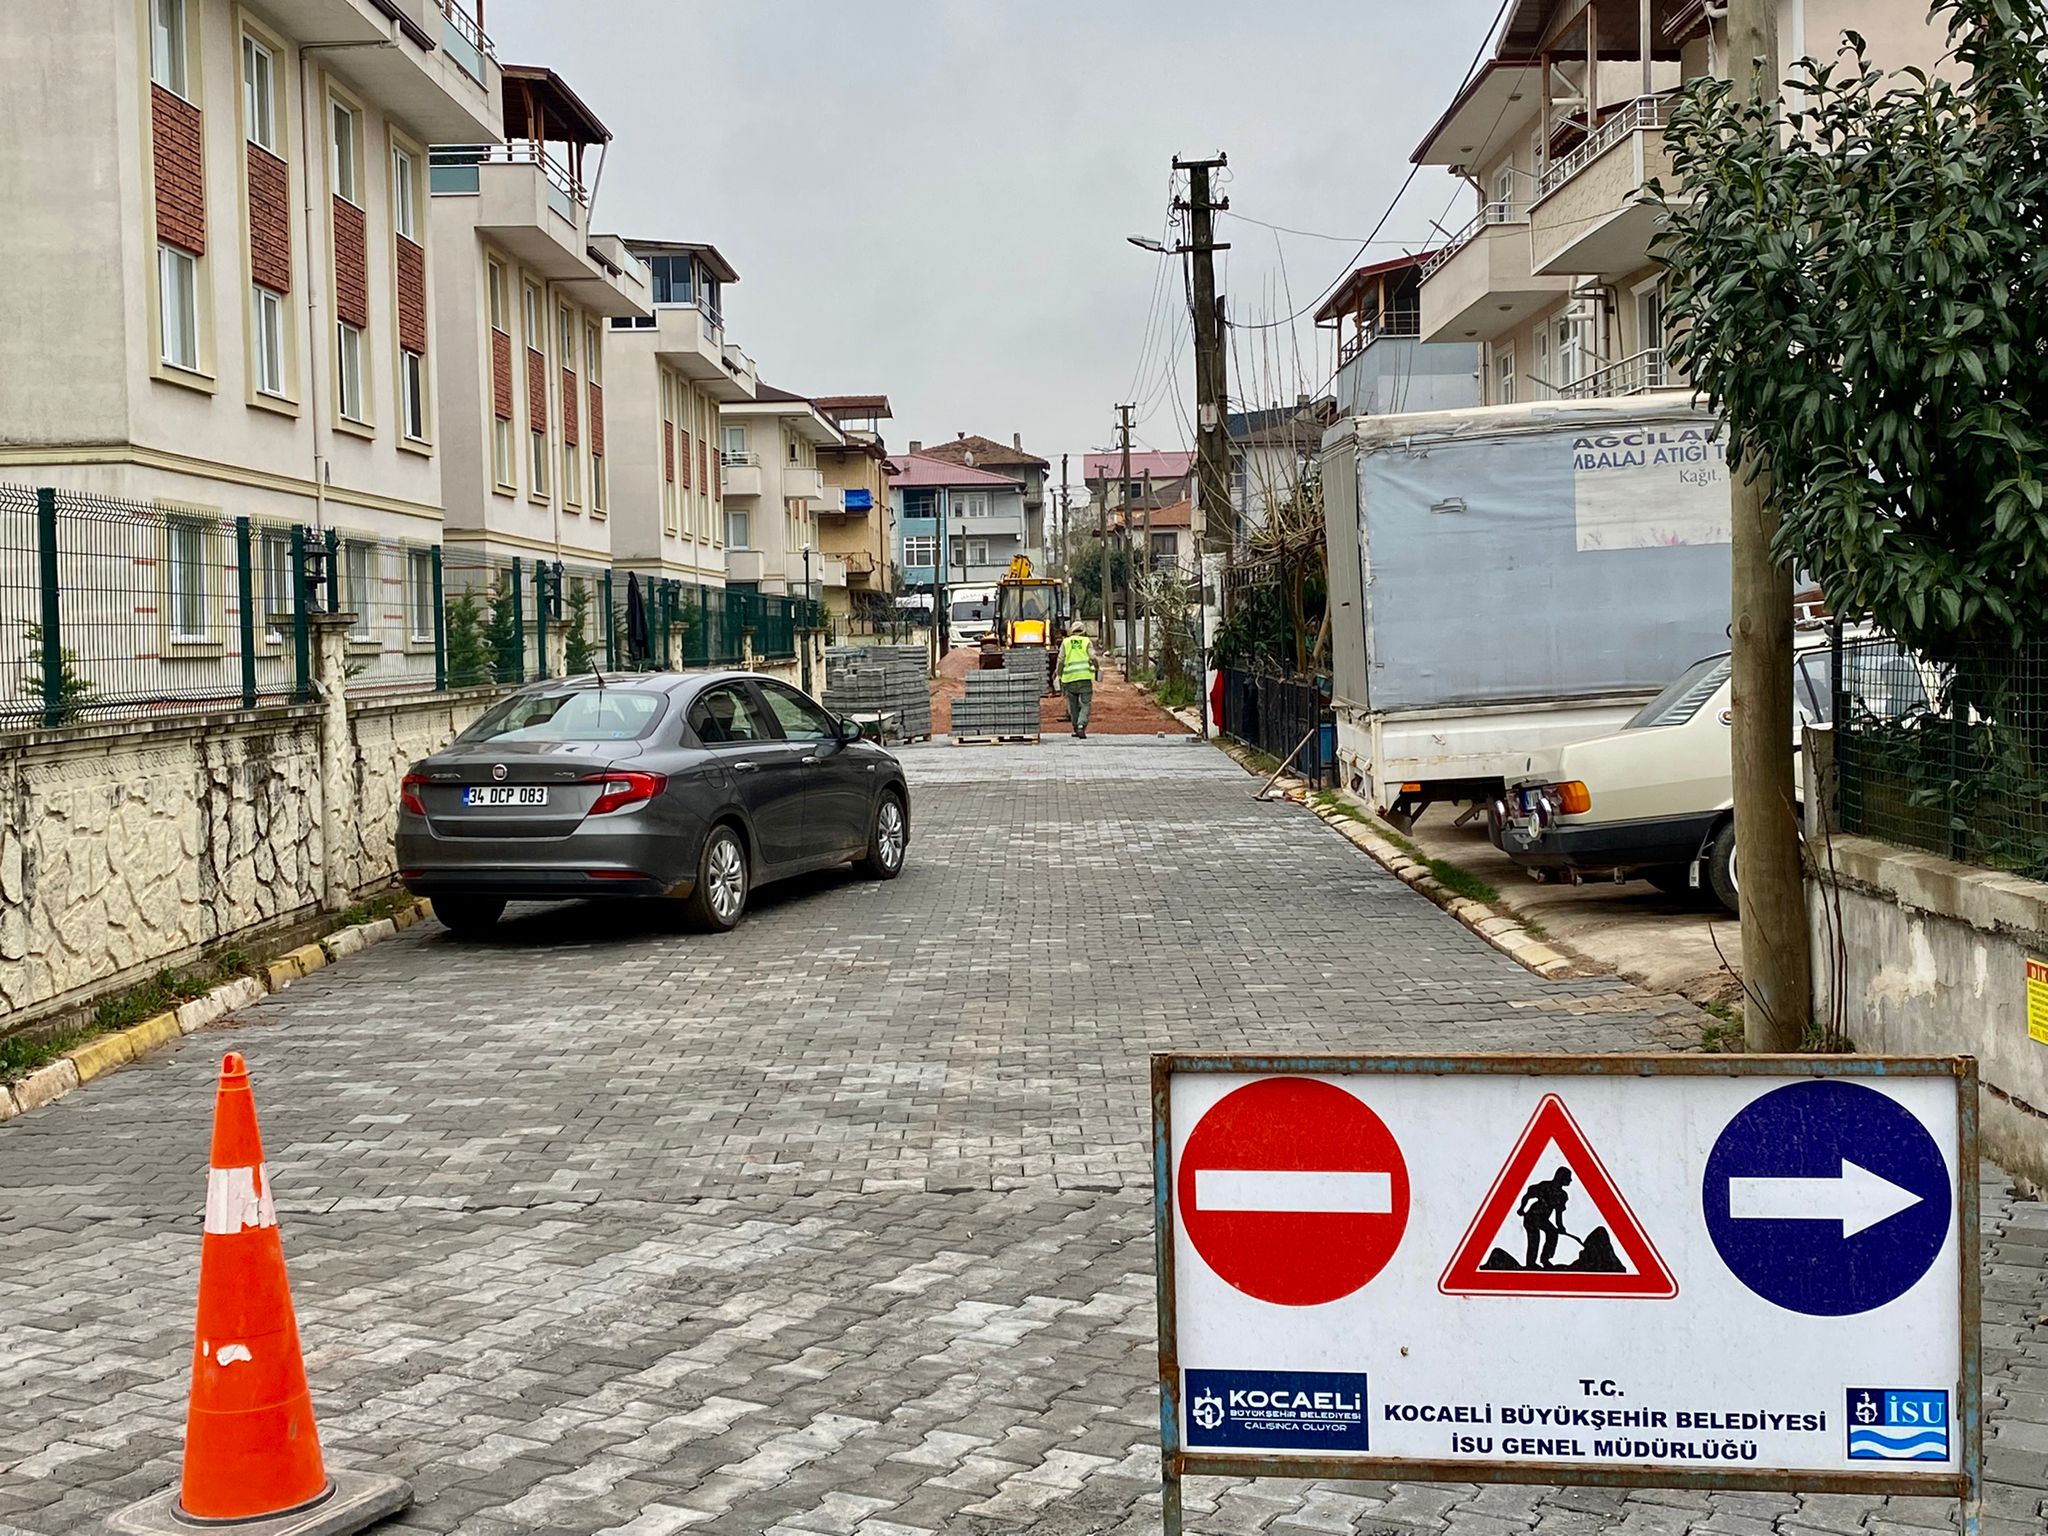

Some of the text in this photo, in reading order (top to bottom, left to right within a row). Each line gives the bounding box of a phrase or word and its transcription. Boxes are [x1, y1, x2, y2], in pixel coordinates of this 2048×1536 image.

[1653, 441, 1707, 464] ATIĞI
[469, 788, 544, 803] 34 DCP 083
[1579, 1379, 1625, 1396] T.C.
[1384, 1403, 1826, 1431] KOCAELİ BÜYÜKŞEHİR BELEDİYESİ
[1302, 1423, 1347, 1432] OLUYOR
[1452, 1432, 1758, 1460] İSU GENEL MÜDÜRLÜĞÜ
